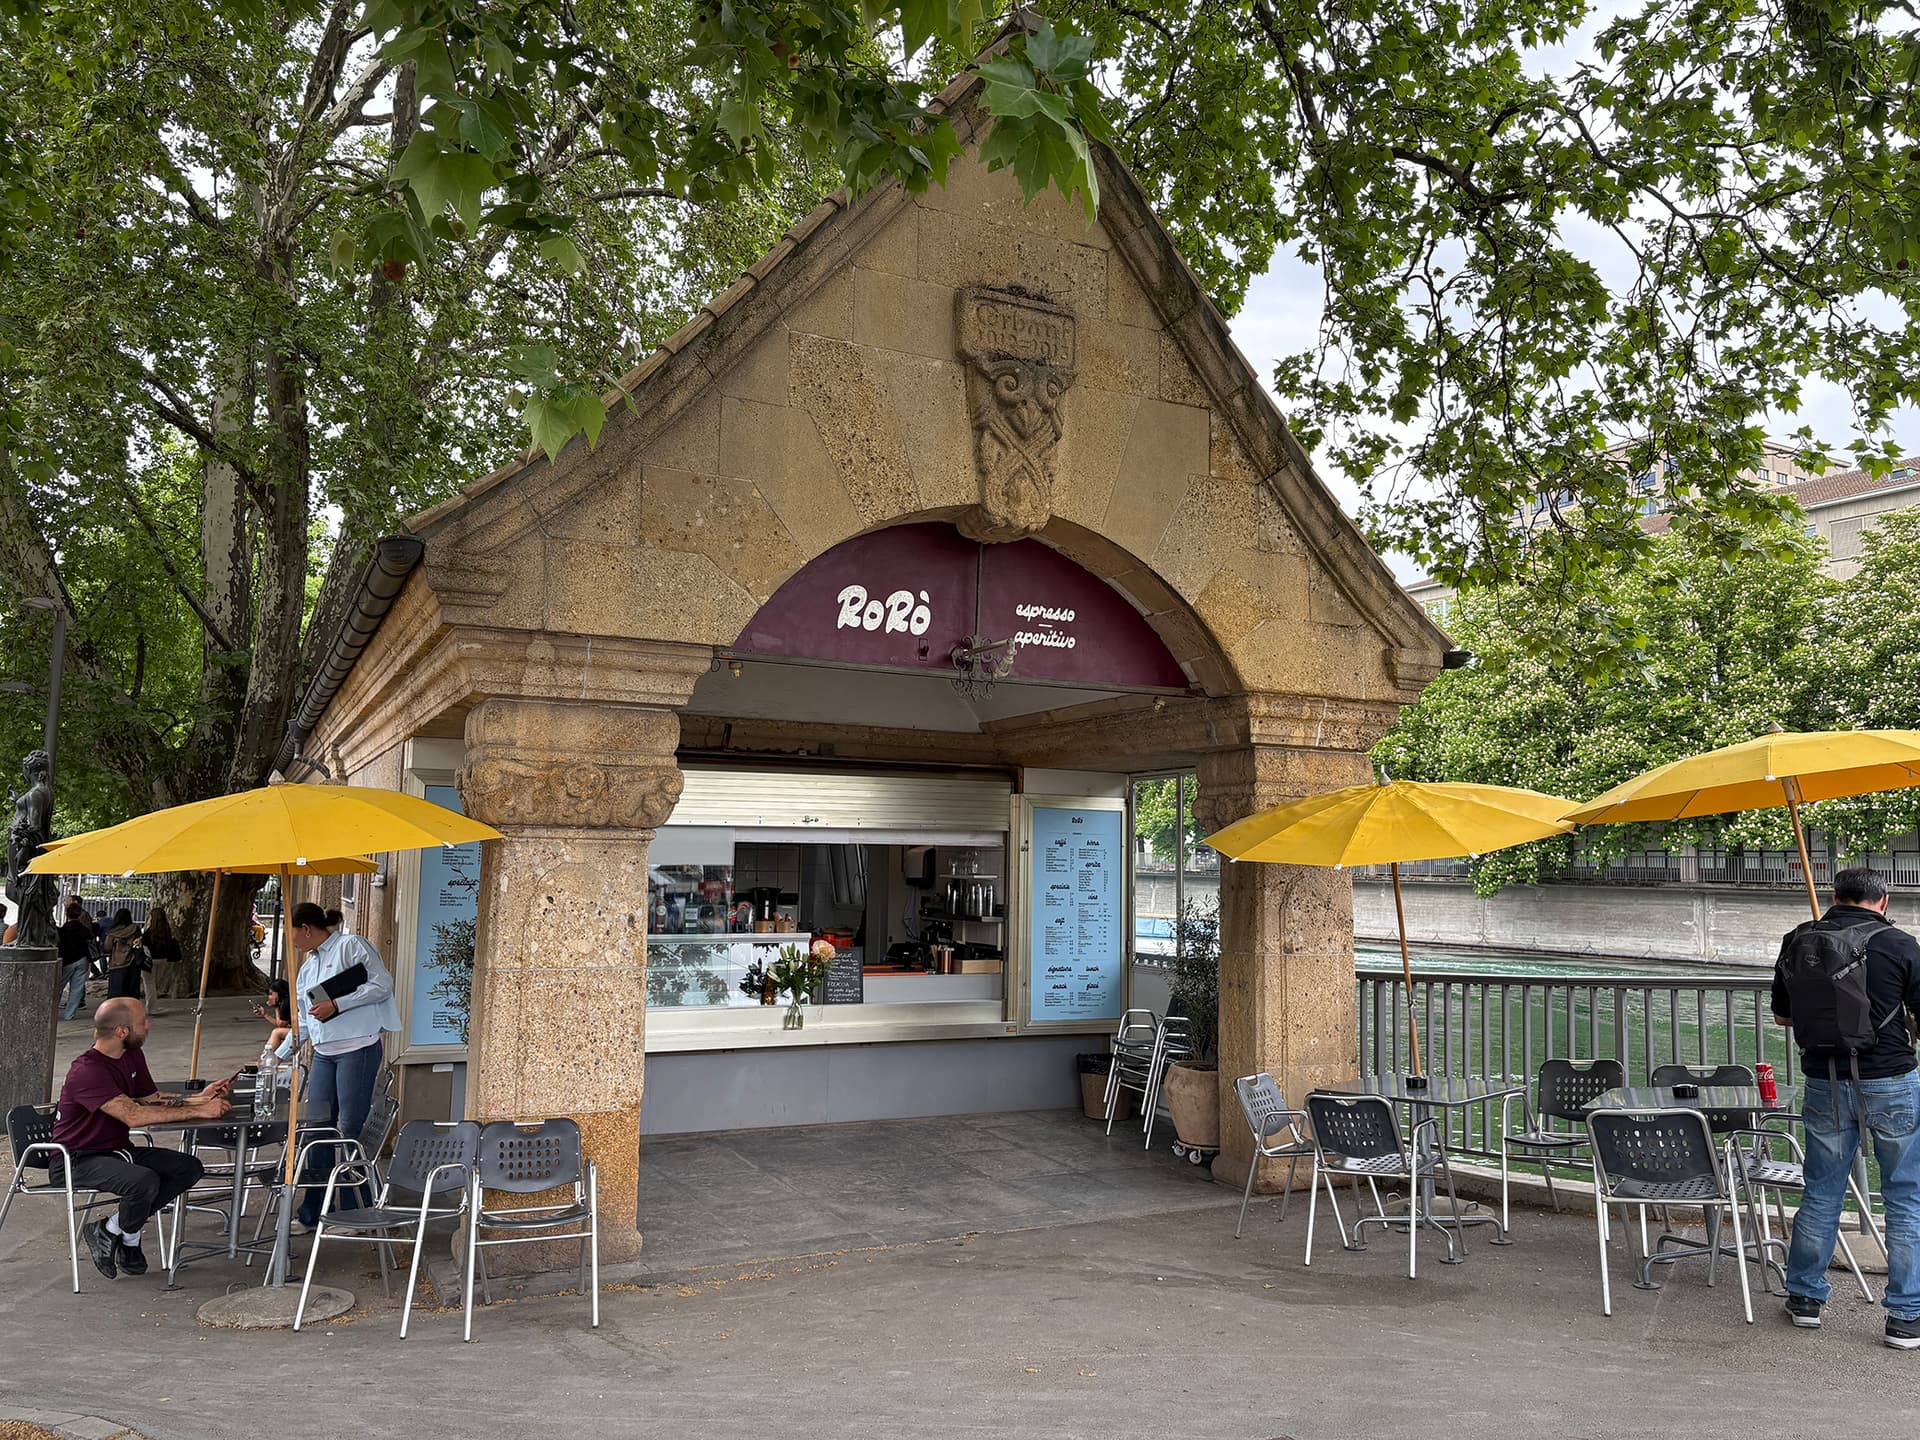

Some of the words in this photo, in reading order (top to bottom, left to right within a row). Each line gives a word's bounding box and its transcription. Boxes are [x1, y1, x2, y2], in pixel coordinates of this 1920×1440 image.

[837, 585, 931, 636] RoRò
[1015, 602, 1076, 624] espresso
[1014, 629, 1076, 649] aperitivo
